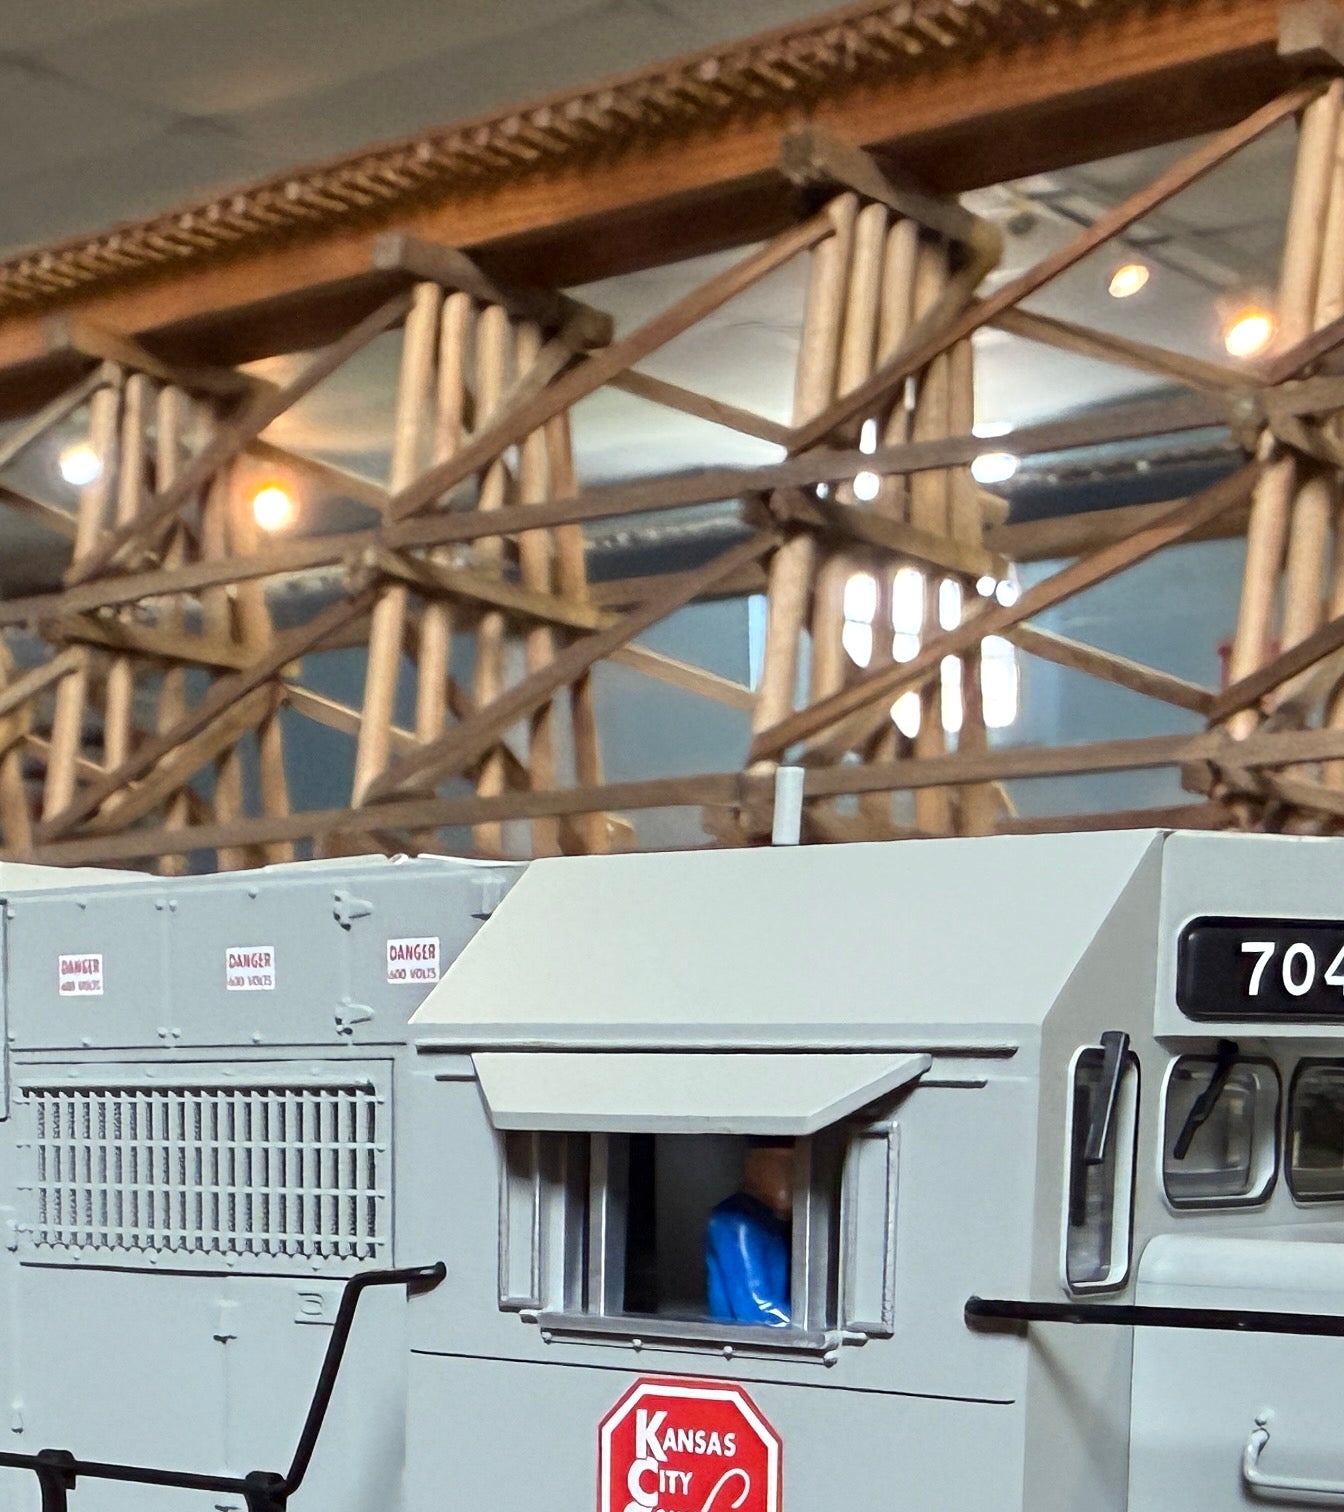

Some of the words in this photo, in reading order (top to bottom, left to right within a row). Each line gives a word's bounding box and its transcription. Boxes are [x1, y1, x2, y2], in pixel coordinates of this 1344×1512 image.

[229, 952, 271, 968] DANGER
[389, 943, 436, 961] DANGER
[634, 1408, 737, 1463] KANSAS
[627, 1456, 693, 1507] CITY
